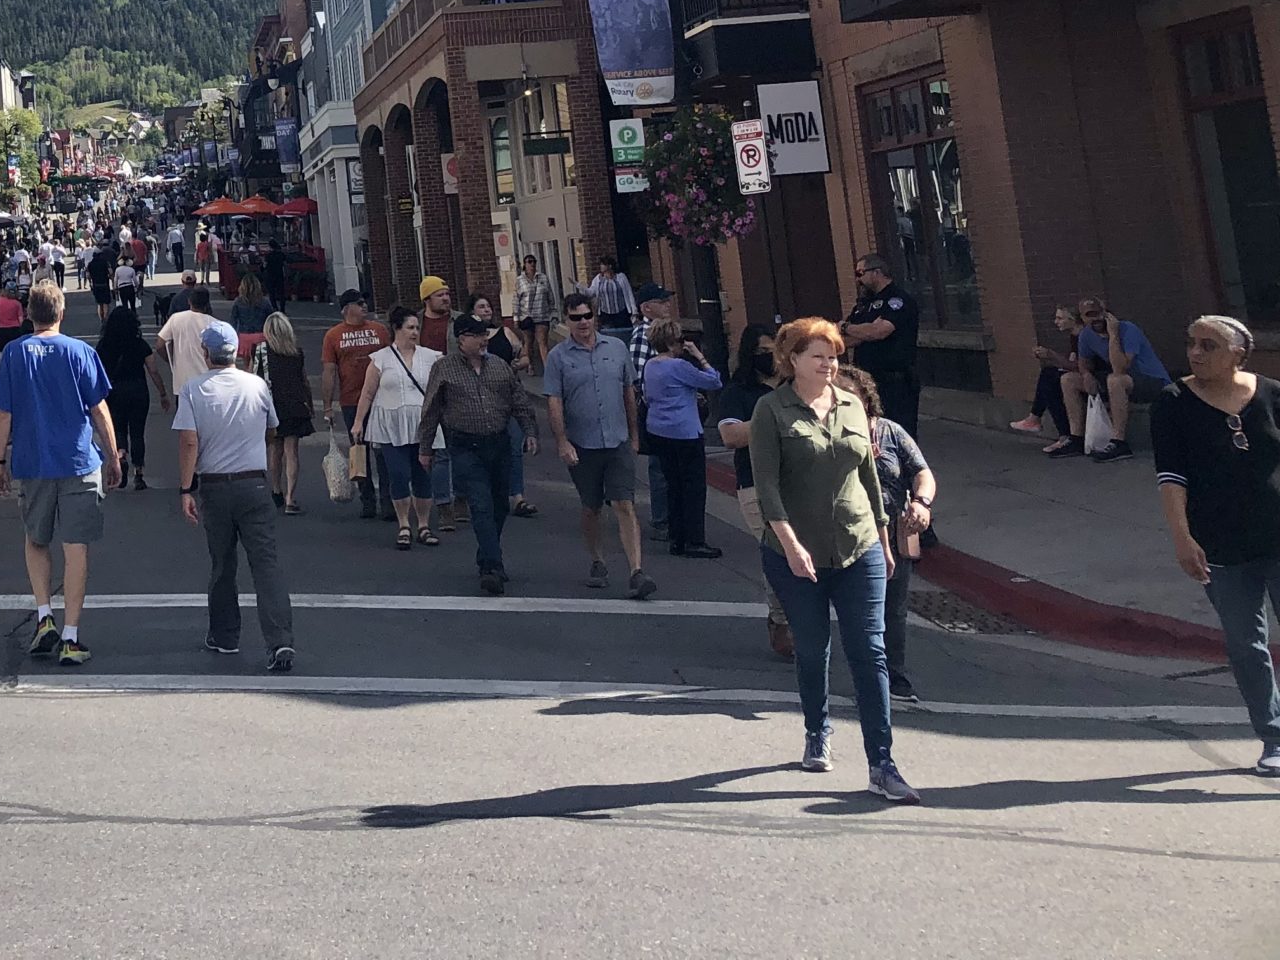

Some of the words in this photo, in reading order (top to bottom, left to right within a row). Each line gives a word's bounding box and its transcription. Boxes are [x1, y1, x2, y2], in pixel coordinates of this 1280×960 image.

[611, 87, 634, 98] Rotary
[623, 129, 633, 142] P
[617, 149, 626, 161] 3
[339, 336, 380, 349] DAVIDSON
